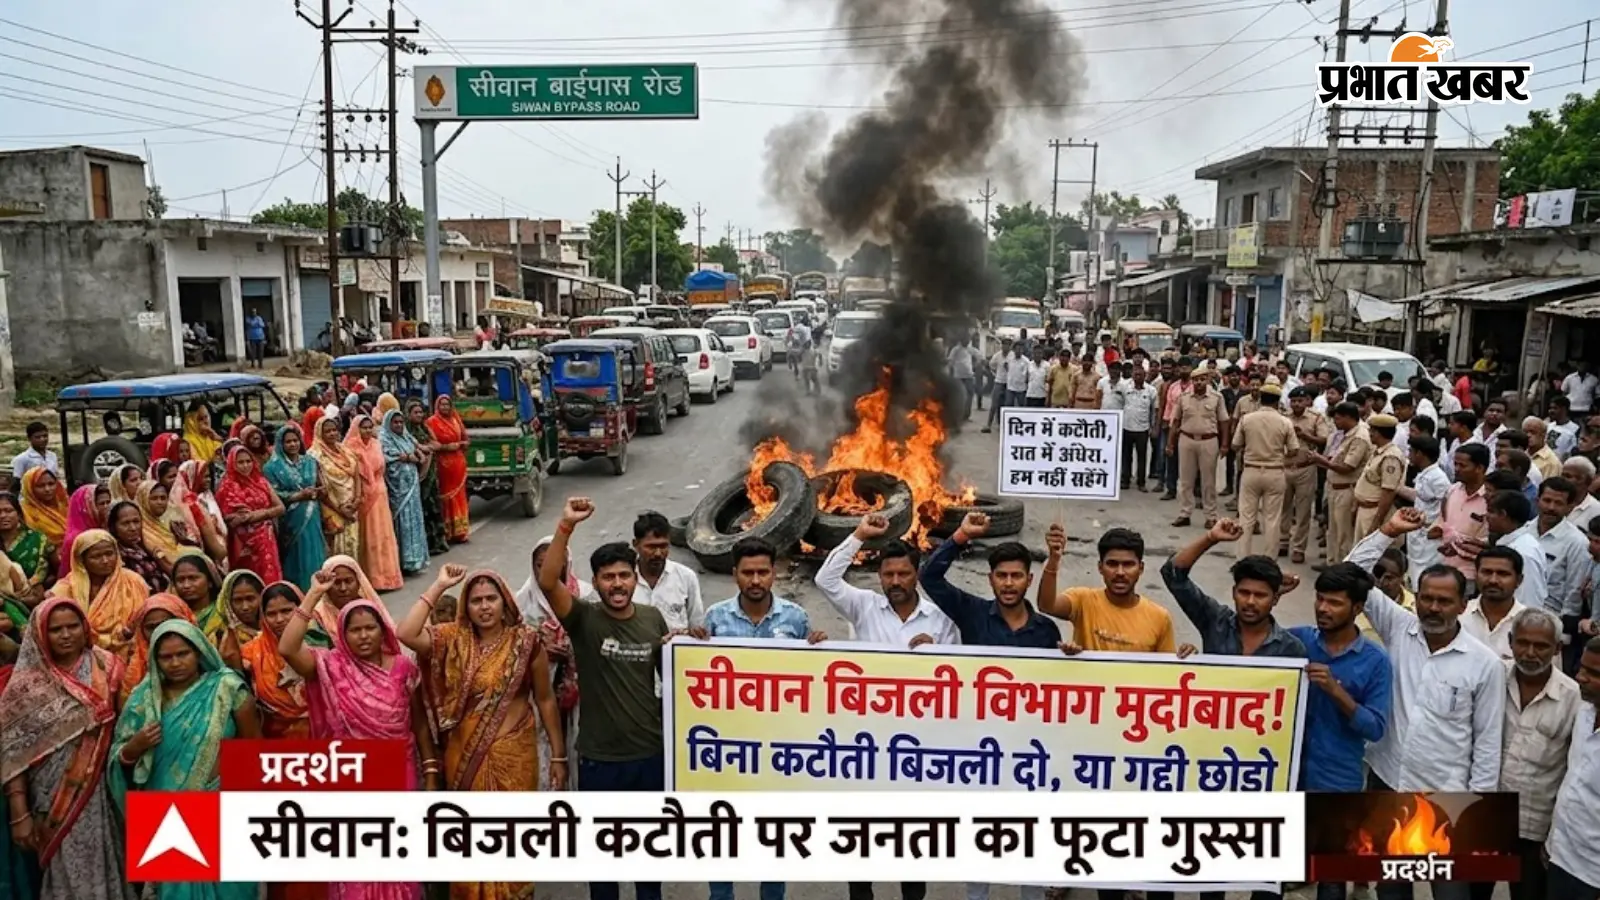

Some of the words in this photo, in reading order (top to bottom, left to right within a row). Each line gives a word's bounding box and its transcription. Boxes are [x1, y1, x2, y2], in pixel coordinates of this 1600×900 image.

[468, 70, 538, 97] सीवान
[547, 68, 632, 99] बाईपास
[643, 69, 683, 96] रोड
[511, 102, 551, 113] SIWAN
[553, 101, 602, 112] BYPASS
[605, 101, 640, 112] ROAD
[1008, 417, 1037, 437] दिन
[1041, 417, 1057, 437] में
[1058, 418, 1112, 442] कटौती,
[1010, 445, 1037, 461] रात
[1041, 442, 1057, 462] में
[1010, 469, 1034, 486] हम
[1038, 467, 1068, 487] नहीं
[1071, 468, 1109, 489] सहेंगे
[685, 655, 813, 712] सीवान
[823, 660, 964, 719] बिजली
[973, 666, 1106, 725] विभाग
[1115, 672, 1286, 743] मुर्दाबाद!
[687, 726, 760, 773] बिना
[771, 729, 878, 780] कटौती
[888, 735, 1004, 786] बिजली
[1013, 739, 1062, 791] दो,
[1074, 754, 1116, 790] या
